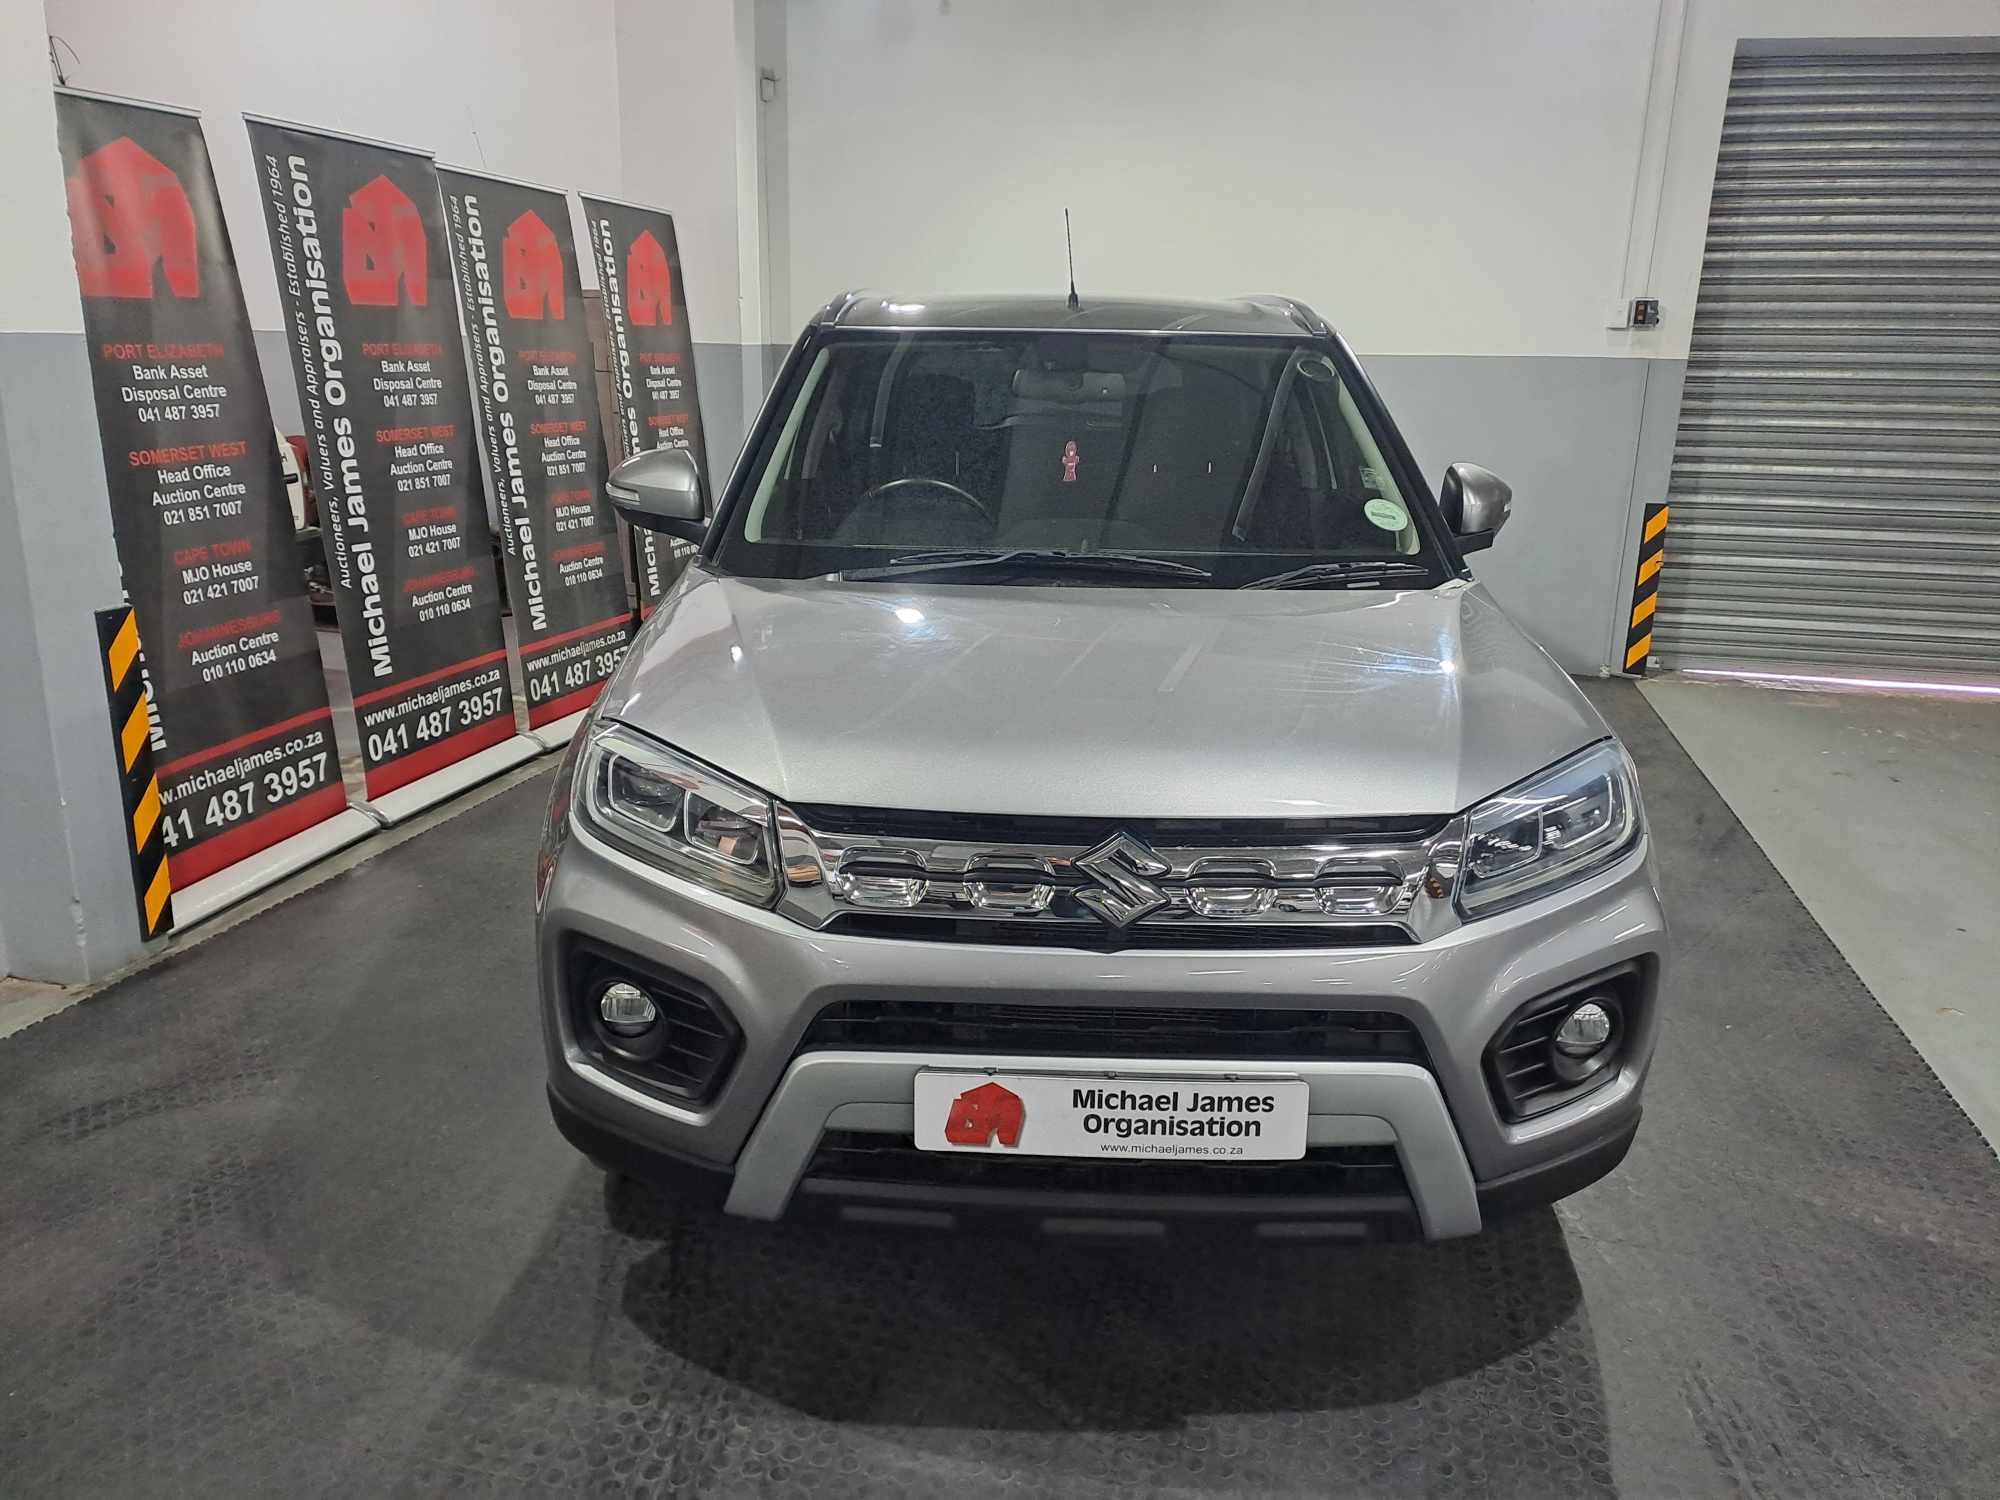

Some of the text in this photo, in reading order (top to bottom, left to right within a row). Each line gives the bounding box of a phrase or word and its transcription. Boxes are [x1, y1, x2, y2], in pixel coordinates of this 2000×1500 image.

[265, 154, 284, 197] 1964
[273, 200, 301, 296] Established
[456, 232, 477, 312] Established
[600, 219, 633, 399] Organisation
[102, 344, 143, 360] PORT
[295, 311, 320, 396] Appraisers
[471, 322, 489, 394] Appraisers
[132, 364, 208, 380] Bank Asset
[381, 360, 431, 373] Bank Asset
[121, 385, 227, 404] Disposal Centre
[373, 377, 442, 392] Disposal Centre
[138, 404, 220, 422] 041 487 3957
[384, 393, 438, 407] 041 487 3957
[481, 395, 493, 422] and
[288, 155, 394, 678] Michael James Organisation
[307, 398, 324, 430] and
[464, 195, 549, 632] Michael James Organisation
[129, 441, 247, 467] SOMERSET WEST
[317, 433, 335, 490] Valuers
[394, 442, 444, 458] Head Office
[487, 424, 502, 474] Valuers
[157, 464, 231, 484] Head Office
[390, 459, 453, 476] Auction Centre
[152, 482, 246, 506] Auction Centre
[397, 474, 450, 492] 021 851 7007
[163, 500, 243, 525] 021 851 7007
[497, 478, 516, 556] Auctioneers,
[328, 496, 353, 588] Auctioneers,
[408, 524, 457, 541] MJO House
[408, 537, 461, 558] 021 421 7007
[182, 560, 253, 585] MJO House
[183, 576, 259, 605] 021 421 7007
[412, 584, 473, 608] Auction Centre
[419, 598, 471, 622] 010 110 0634
[191, 631, 279, 666] Auction Centre
[526, 630, 626, 673] www.michaeljames.co.za
[202, 649, 277, 683] 010 110 0634
[530, 671, 560, 701] 041
[565, 660, 591, 688] 487
[364, 669, 500, 727] www.michaeljames.co.za
[368, 687, 503, 762] 041 487 3957
[205, 782, 255, 828] 487
[263, 752, 328, 803] 3957
[1073, 1089, 1275, 1113] Michael James
[1083, 1113, 1262, 1139] Organisation
[1100, 1144, 1244, 1157] www.michaeljames.co.za
